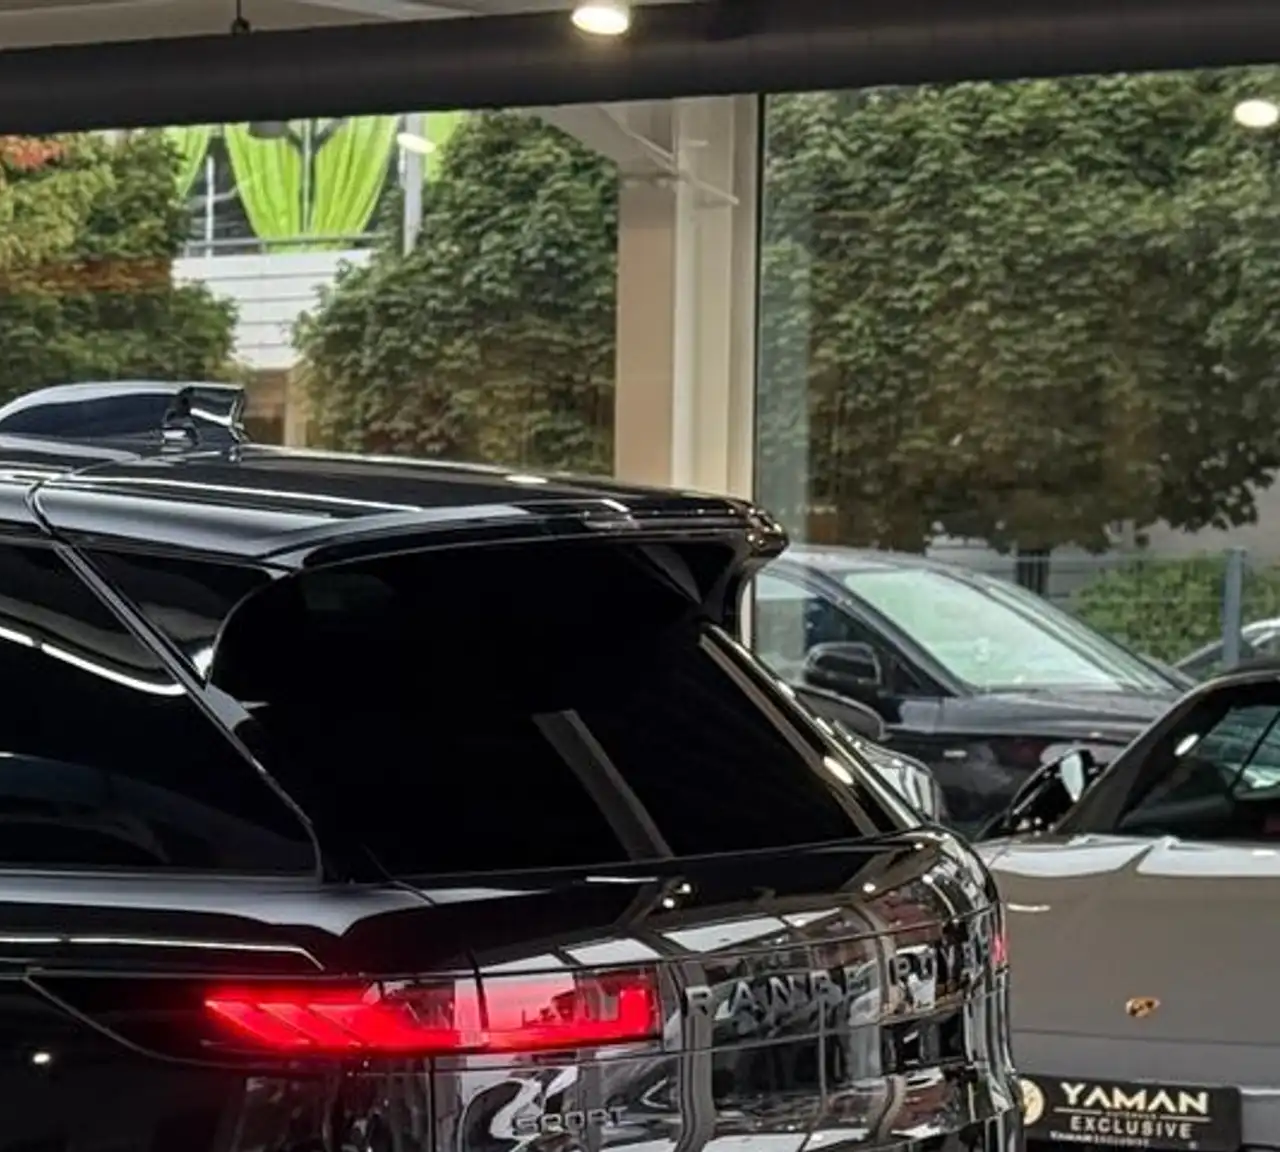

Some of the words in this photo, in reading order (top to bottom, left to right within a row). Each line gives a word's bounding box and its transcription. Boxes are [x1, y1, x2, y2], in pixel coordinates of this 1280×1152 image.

[1060, 1081, 1209, 1114] YAMAN
[512, 1106, 628, 1136] SPORT
[1070, 1115, 1192, 1139] EXCLUSIVE
